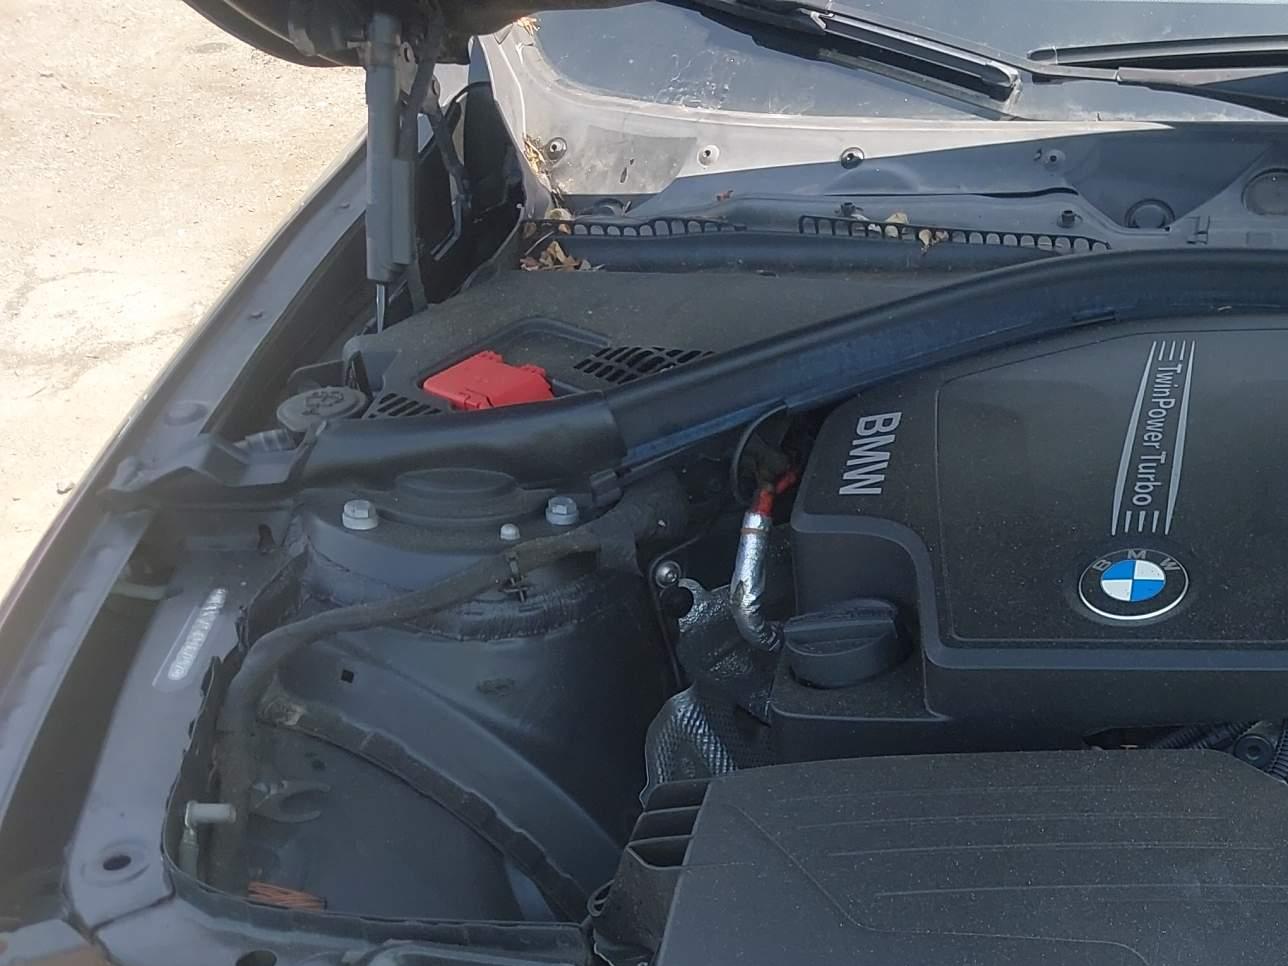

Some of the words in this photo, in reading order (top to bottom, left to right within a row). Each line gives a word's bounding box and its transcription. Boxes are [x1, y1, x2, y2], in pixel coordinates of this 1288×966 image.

[1143, 363, 1182, 450] TwinPower
[838, 411, 902, 496] BMW
[1133, 452, 1167, 507] Turbo
[1091, 549, 1181, 573] BMW
